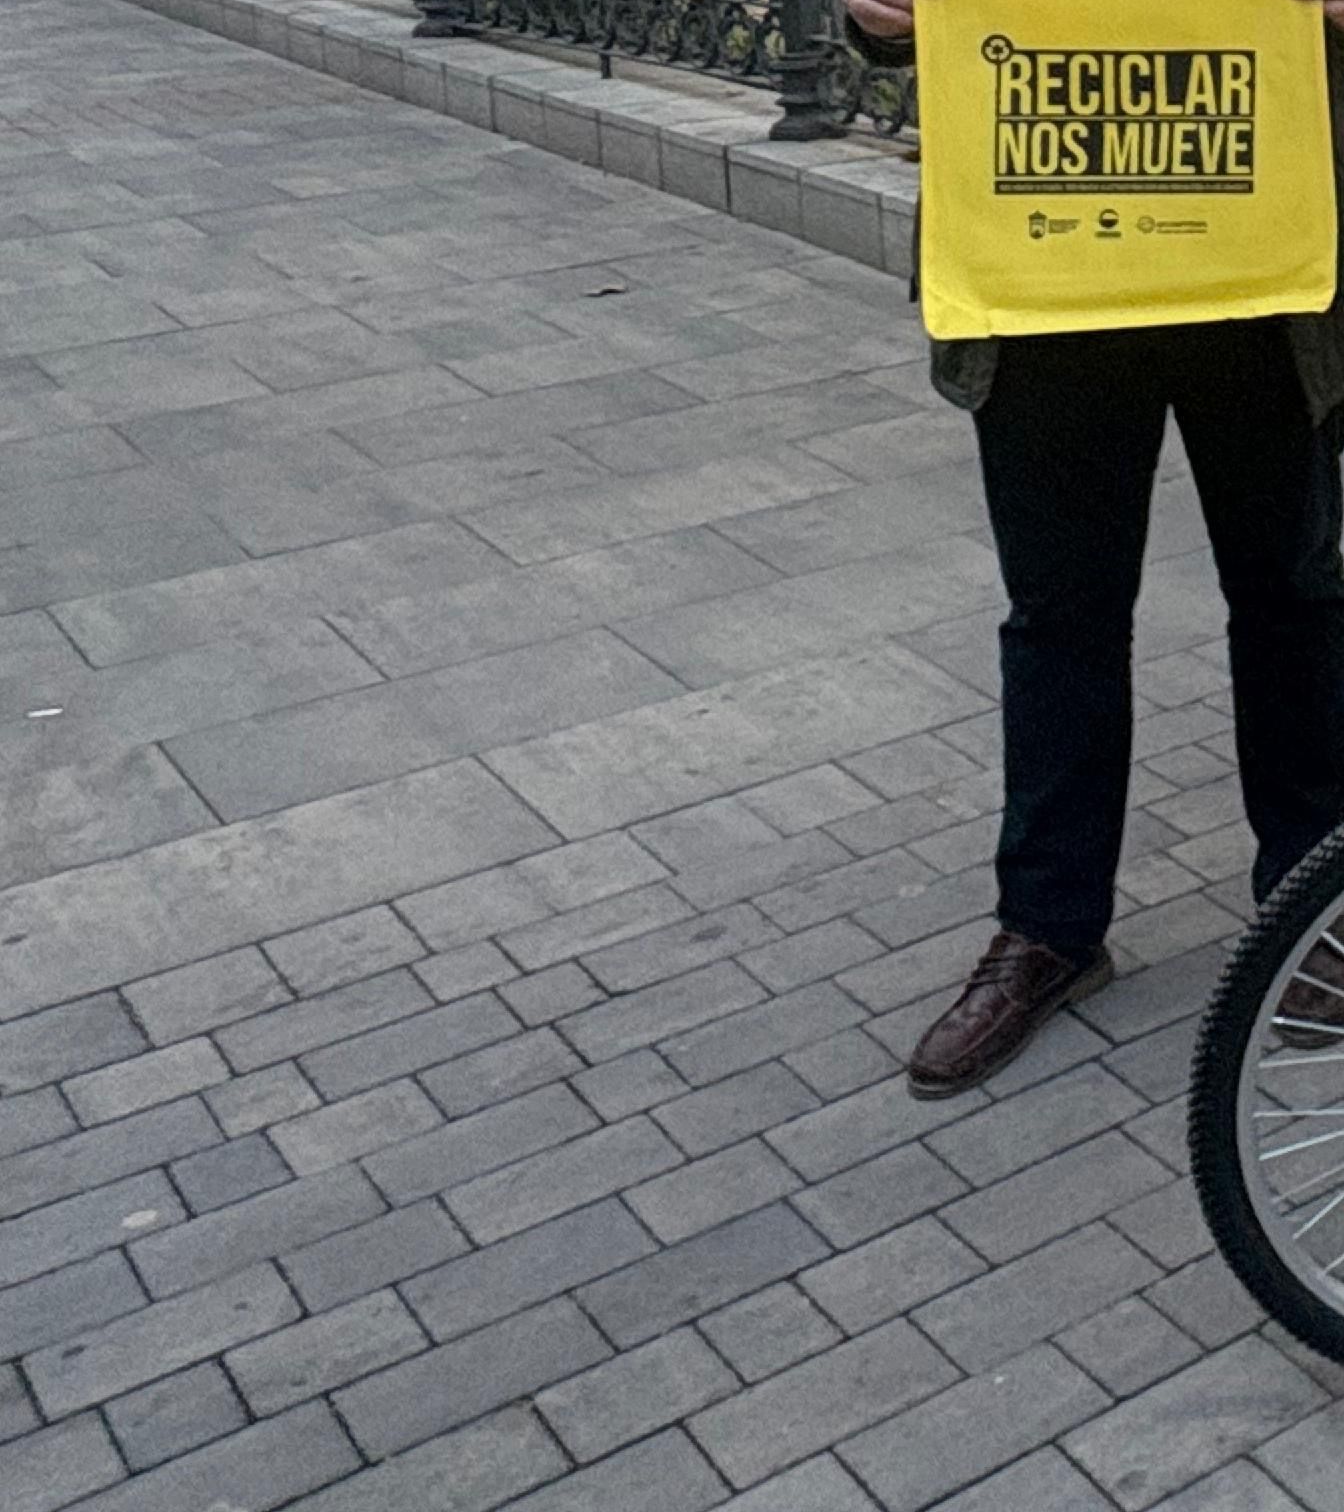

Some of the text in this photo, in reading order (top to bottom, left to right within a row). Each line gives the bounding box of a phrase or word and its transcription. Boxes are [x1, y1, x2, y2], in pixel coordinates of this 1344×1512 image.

[999, 53, 1251, 116] RECICLAR
[998, 121, 1251, 175] NOS MUEVE
